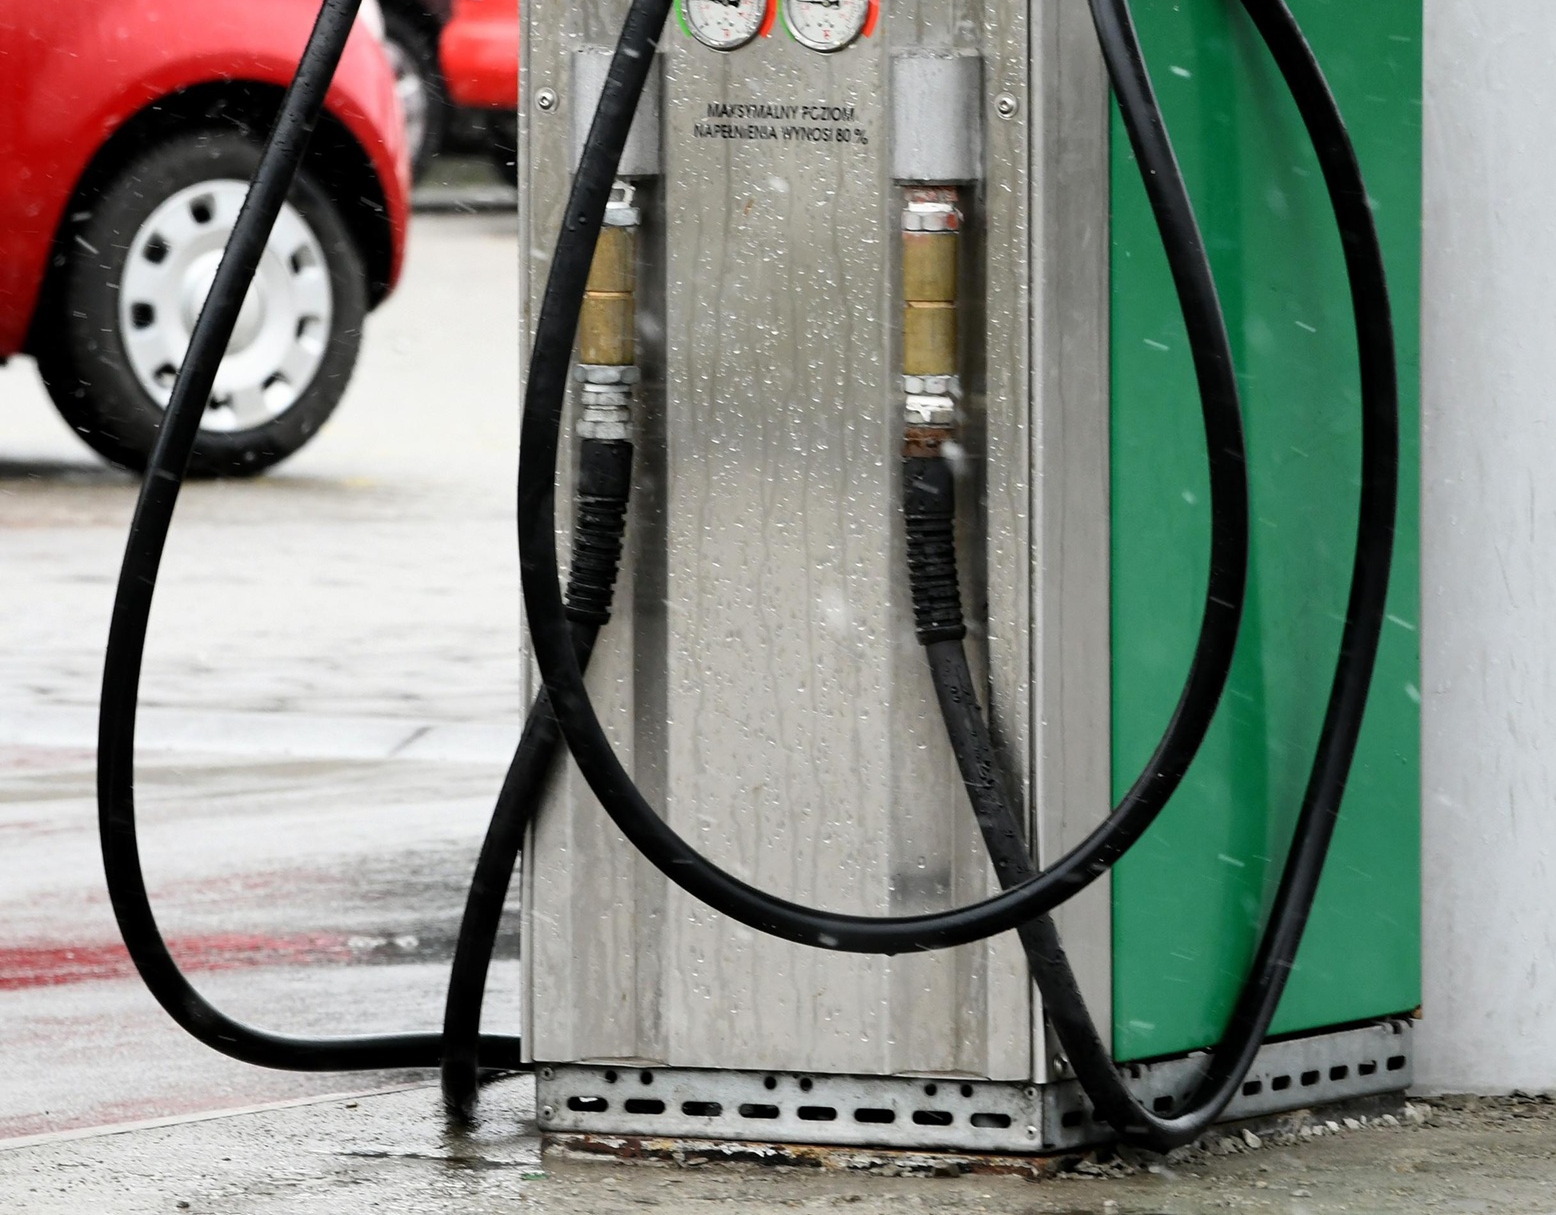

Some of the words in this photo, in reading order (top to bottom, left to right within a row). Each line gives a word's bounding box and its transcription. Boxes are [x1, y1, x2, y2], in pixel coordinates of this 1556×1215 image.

[706, 103, 799, 121] MAKSYMALNY
[781, 126, 834, 143] WYNOSI
[835, 127, 851, 143] 80
[853, 128, 869, 146] %
